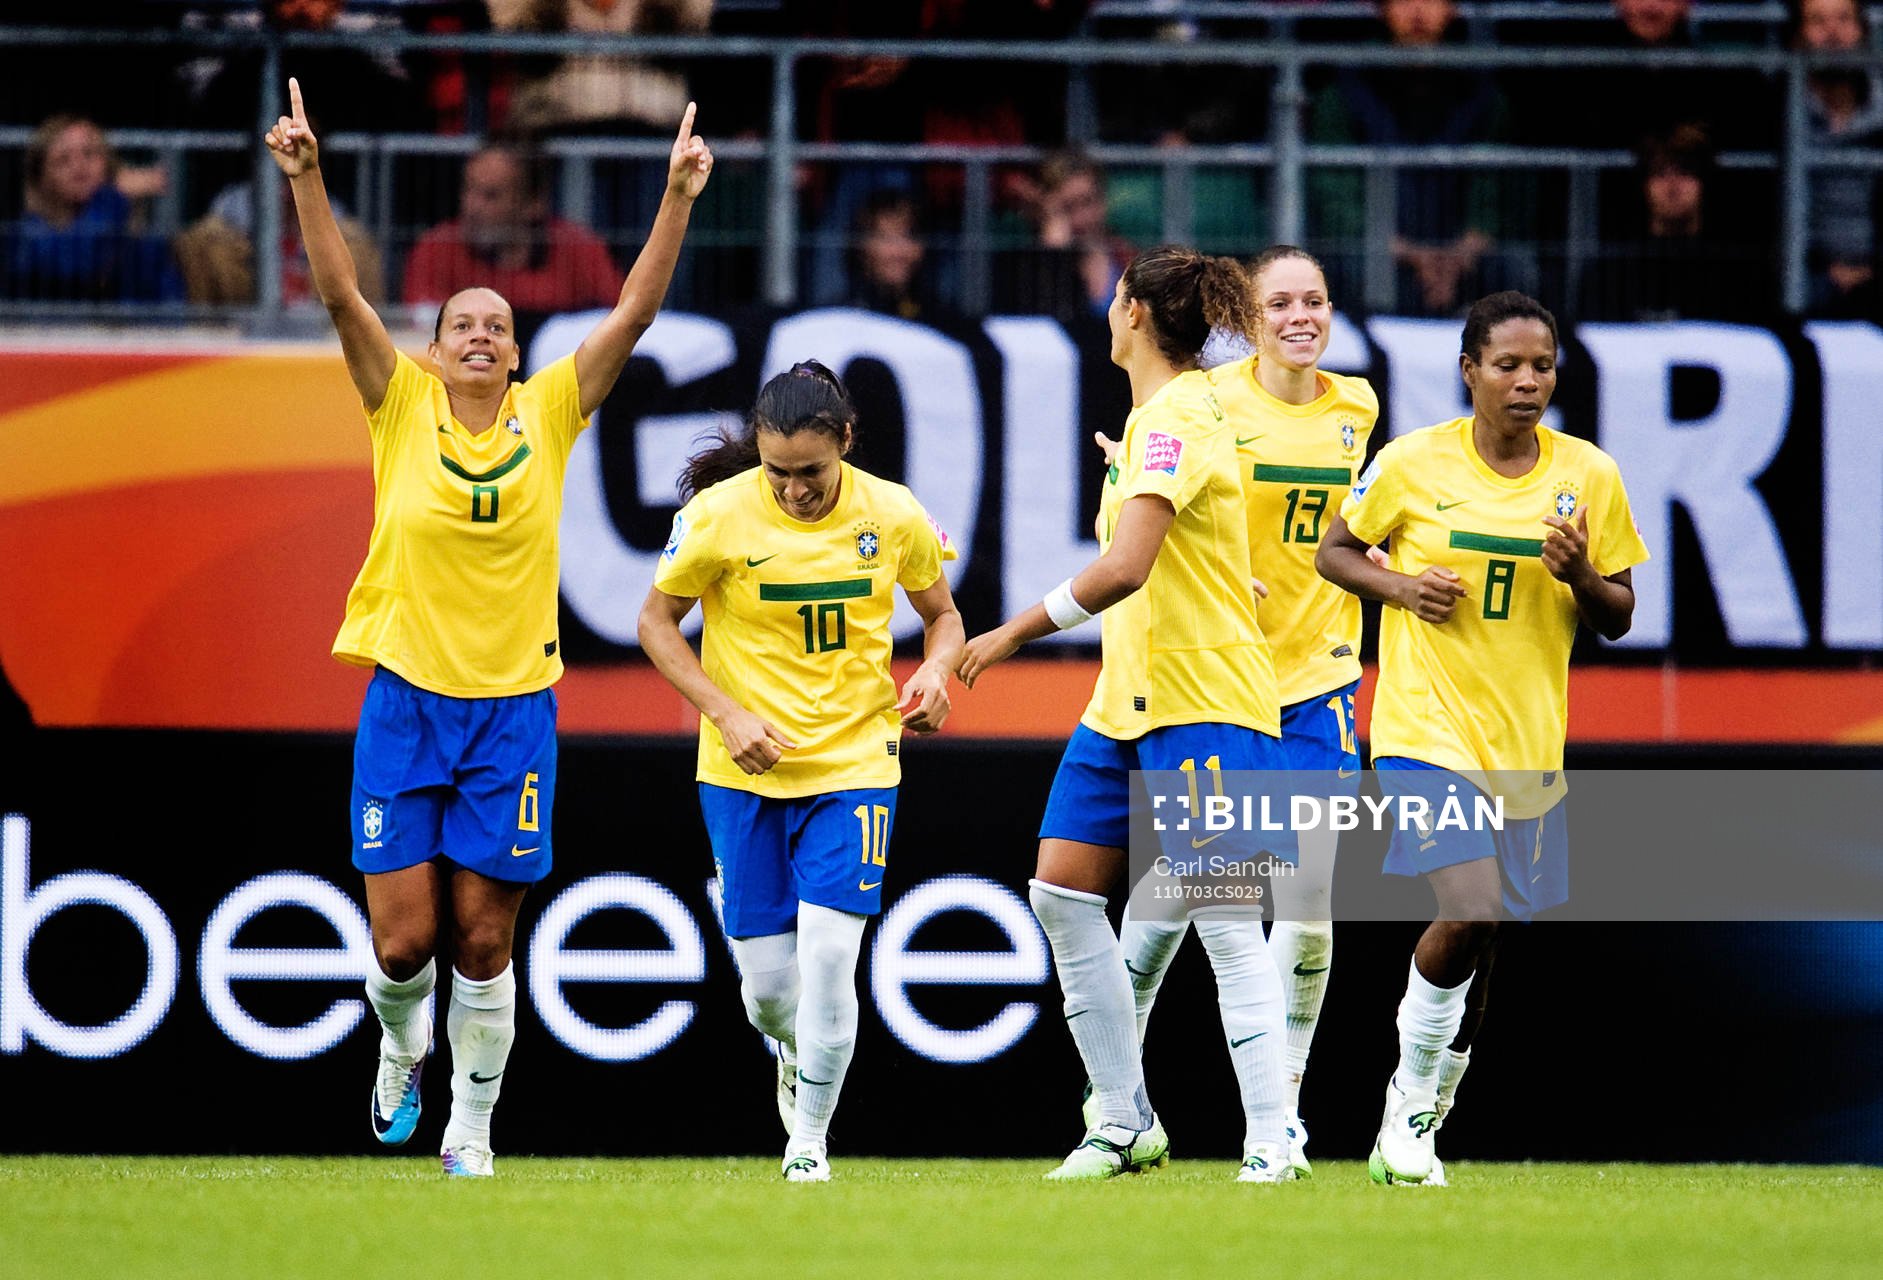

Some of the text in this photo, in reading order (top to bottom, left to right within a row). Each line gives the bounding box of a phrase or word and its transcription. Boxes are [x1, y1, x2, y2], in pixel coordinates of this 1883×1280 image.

[1283, 488, 1329, 544] 13
[1483, 559, 1517, 620] 8
[796, 602, 847, 655] 10
[517, 771, 540, 832] 6
[852, 804, 890, 868] 10
